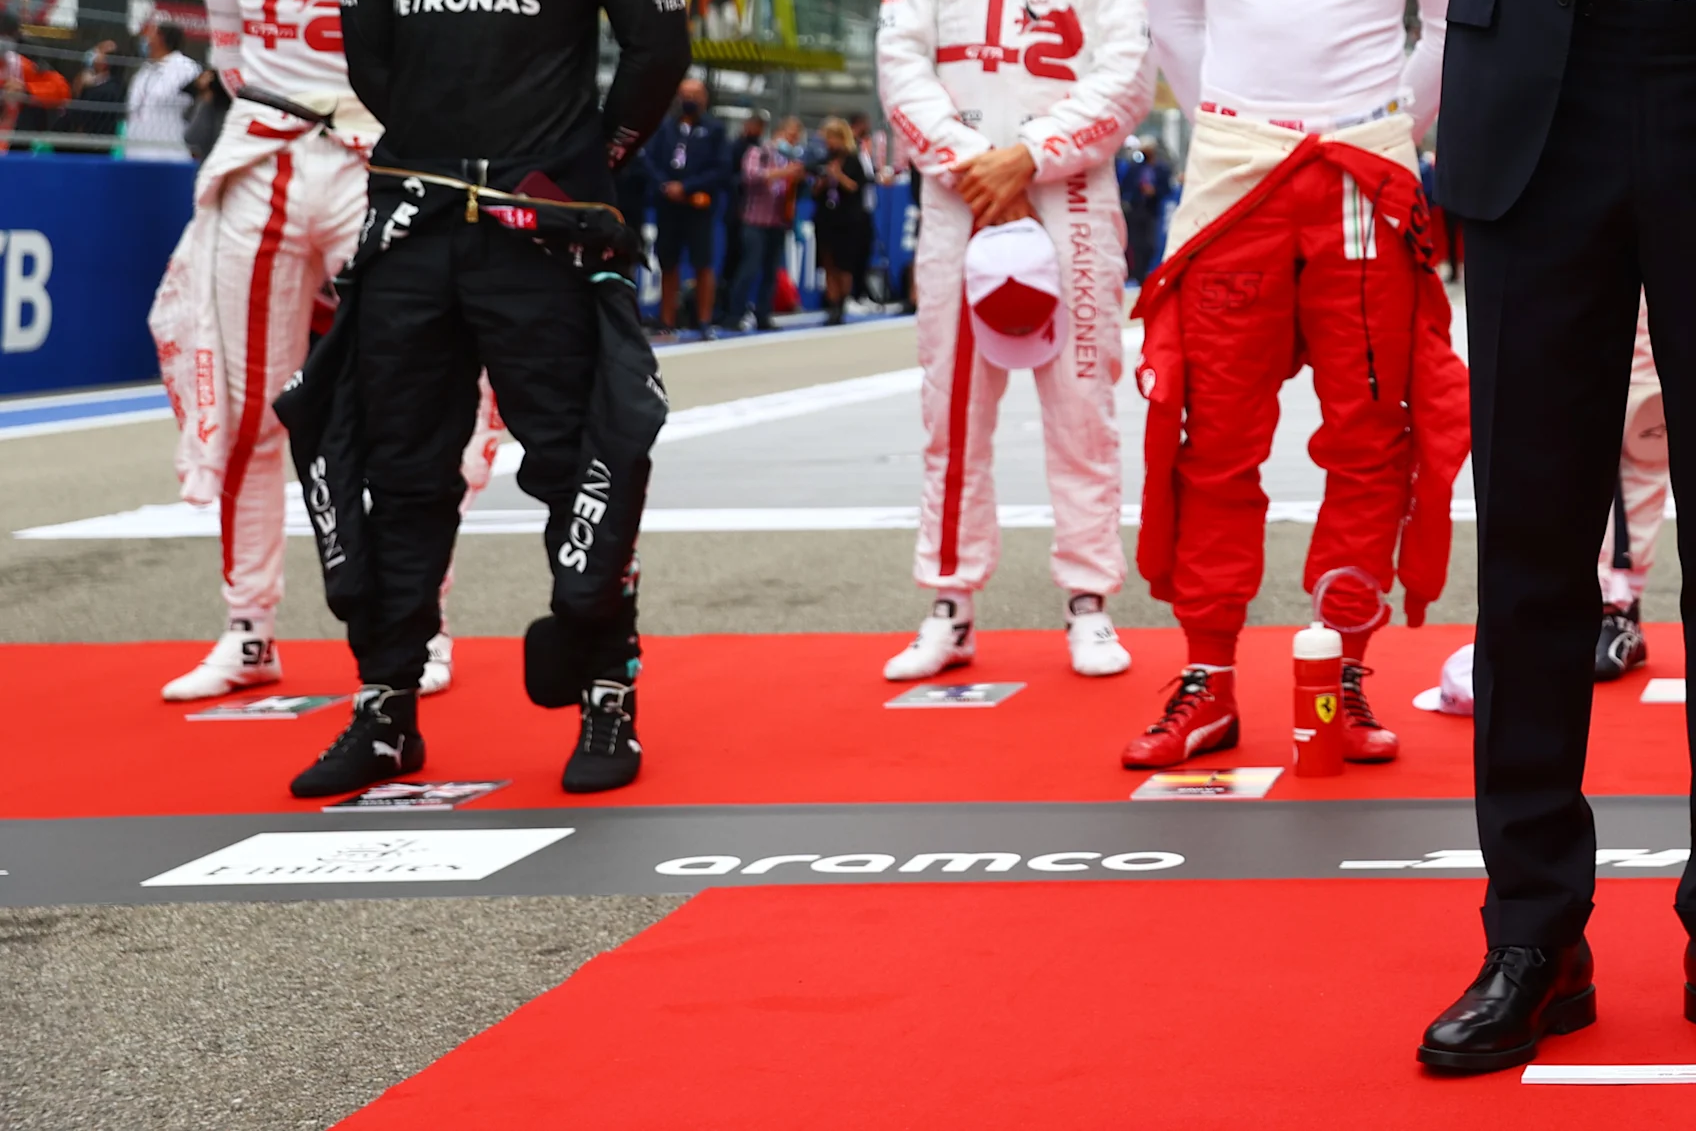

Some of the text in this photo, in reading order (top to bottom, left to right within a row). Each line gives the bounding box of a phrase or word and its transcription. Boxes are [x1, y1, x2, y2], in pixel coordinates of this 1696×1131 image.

[1200, 271, 1264, 311] 55
[558, 458, 612, 574] INEOS
[655, 851, 1186, 875] aramco
